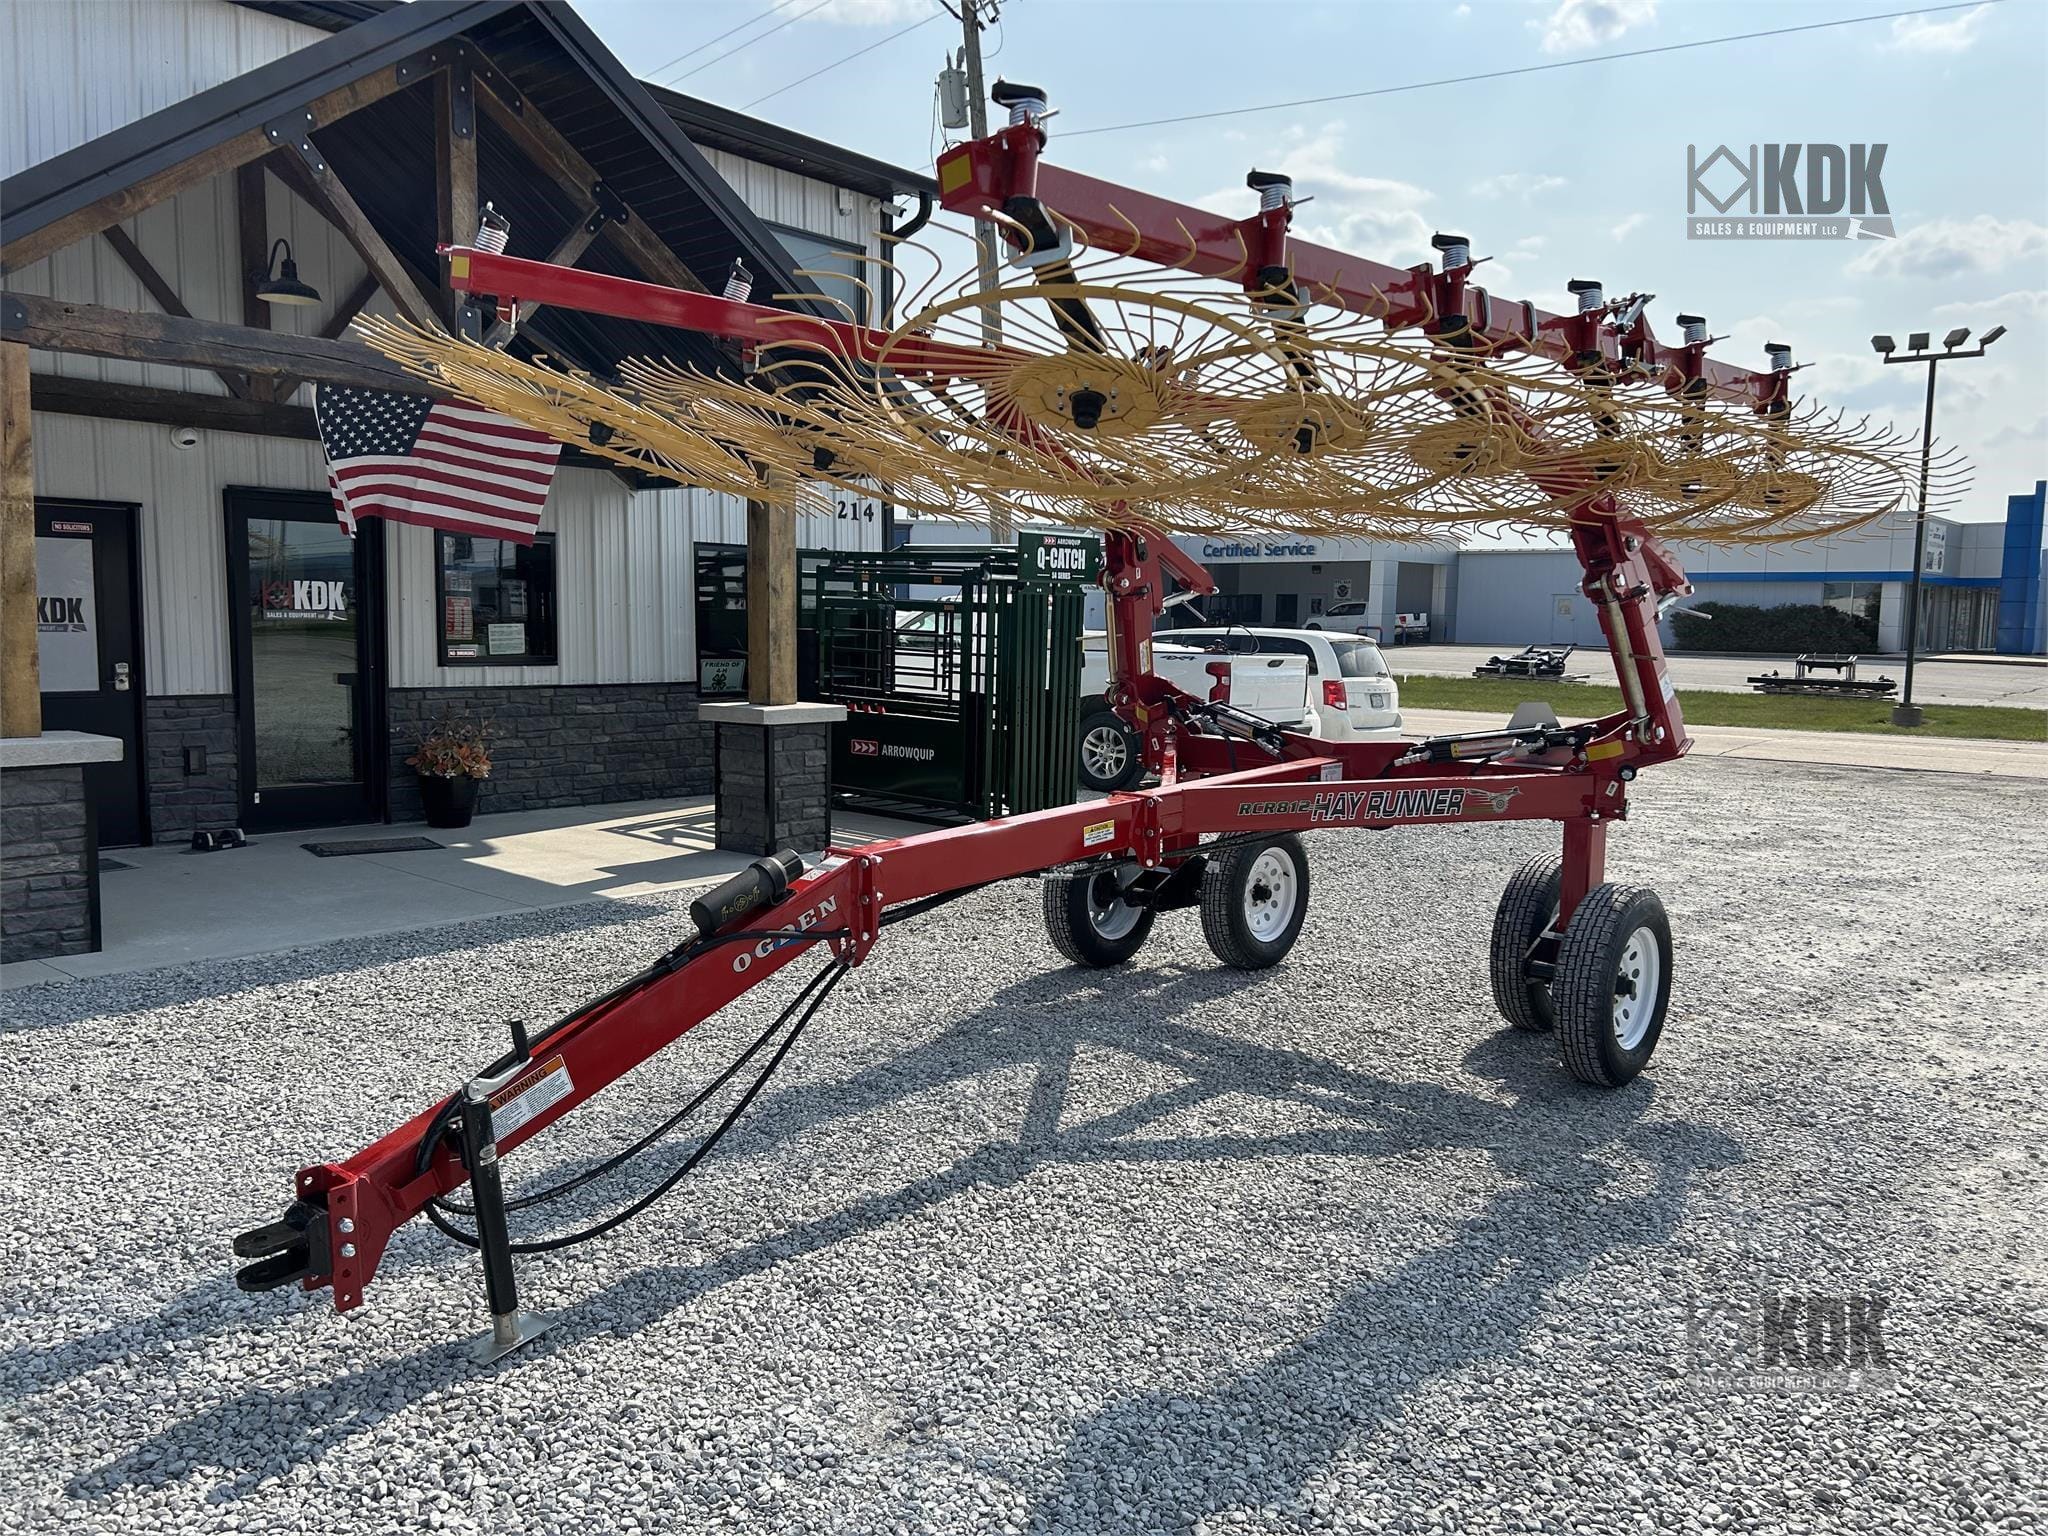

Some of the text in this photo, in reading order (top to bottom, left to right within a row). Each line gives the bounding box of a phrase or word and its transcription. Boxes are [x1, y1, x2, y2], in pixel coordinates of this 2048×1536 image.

[837, 500, 875, 523] 214
[1057, 537, 1082, 547] ARROWQUIP
[1202, 541, 1316, 558] Certified Service
[1037, 546, 1086, 570] Q-CATCH
[293, 580, 346, 611] KDK
[36, 597, 85, 624] KDK
[881, 744, 935, 762] ARROWQUIP
[1237, 788, 1466, 822] RCR812 HAY RUNNER
[496, 1067, 549, 1106] WARNING
